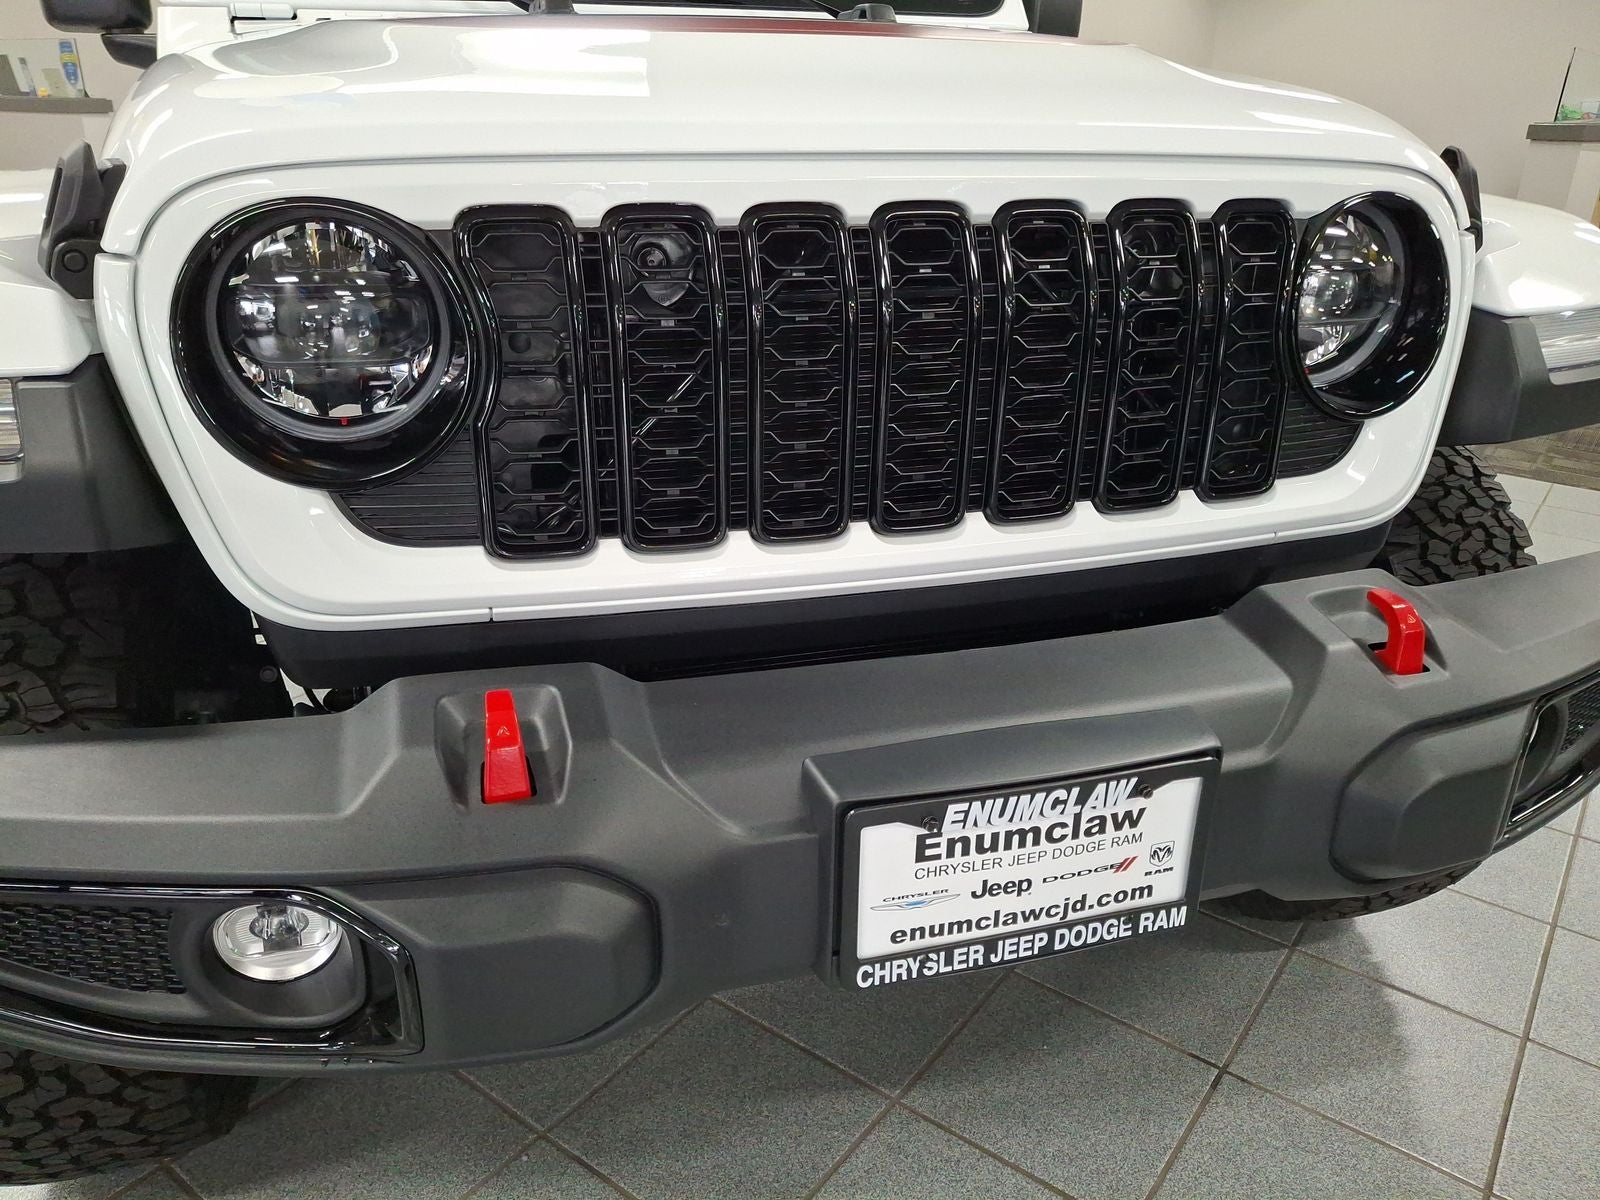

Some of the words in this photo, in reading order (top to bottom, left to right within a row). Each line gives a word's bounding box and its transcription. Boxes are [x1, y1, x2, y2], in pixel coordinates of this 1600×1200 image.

[941, 776, 1138, 833] ENUMCLAW
[914, 856, 1002, 880] CHRYSLER
[1008, 850, 1047, 867] JEEP
[1053, 839, 1107, 860] DODGE
[1111, 832, 1143, 847] RAM
[915, 806, 1148, 864] Enumclaw
[883, 888, 949, 902] CHRYSLER
[971, 876, 1032, 899] Jeep
[1042, 863, 1121, 884] DODGE
[1144, 867, 1174, 876] RAM
[890, 884, 1153, 945] enumclawcjd.com
[856, 944, 984, 989] CHRYSLER
[990, 932, 1049, 963] JEEP
[1054, 915, 1132, 952] DODGE
[1138, 906, 1186, 934] RAM
